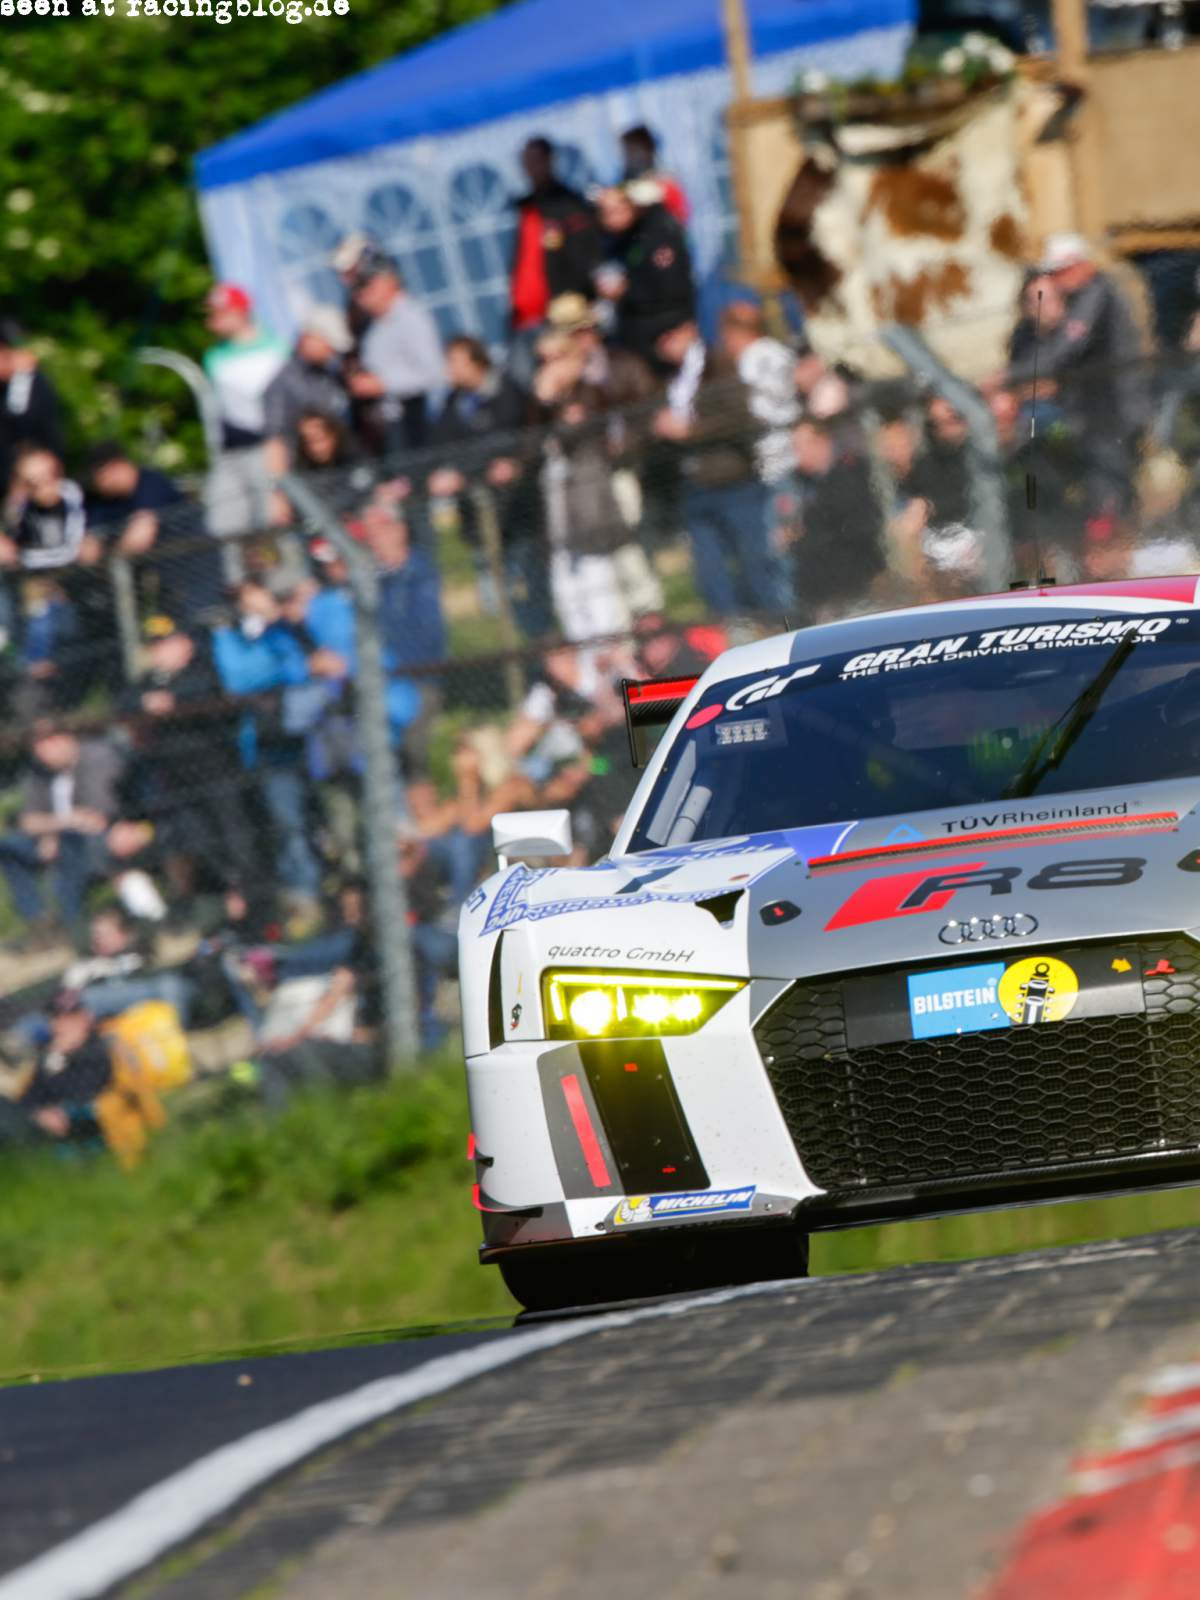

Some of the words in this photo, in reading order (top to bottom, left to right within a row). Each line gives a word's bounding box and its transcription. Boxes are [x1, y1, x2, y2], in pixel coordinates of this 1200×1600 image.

[838, 665, 880, 681] THE
[884, 655, 938, 671] REAL
[943, 640, 1029, 661] DRIVING
[1033, 635, 1156, 649] SIMULATOR
[843, 636, 967, 674] GRAN
[980, 617, 1171, 649] TURISMO
[899, 856, 1147, 910] R8
[548, 944, 621, 960] quattro
[626, 947, 695, 963] GmbH
[914, 986, 996, 1015] BILSTEIN
[655, 1191, 752, 1210] MICHELIN
